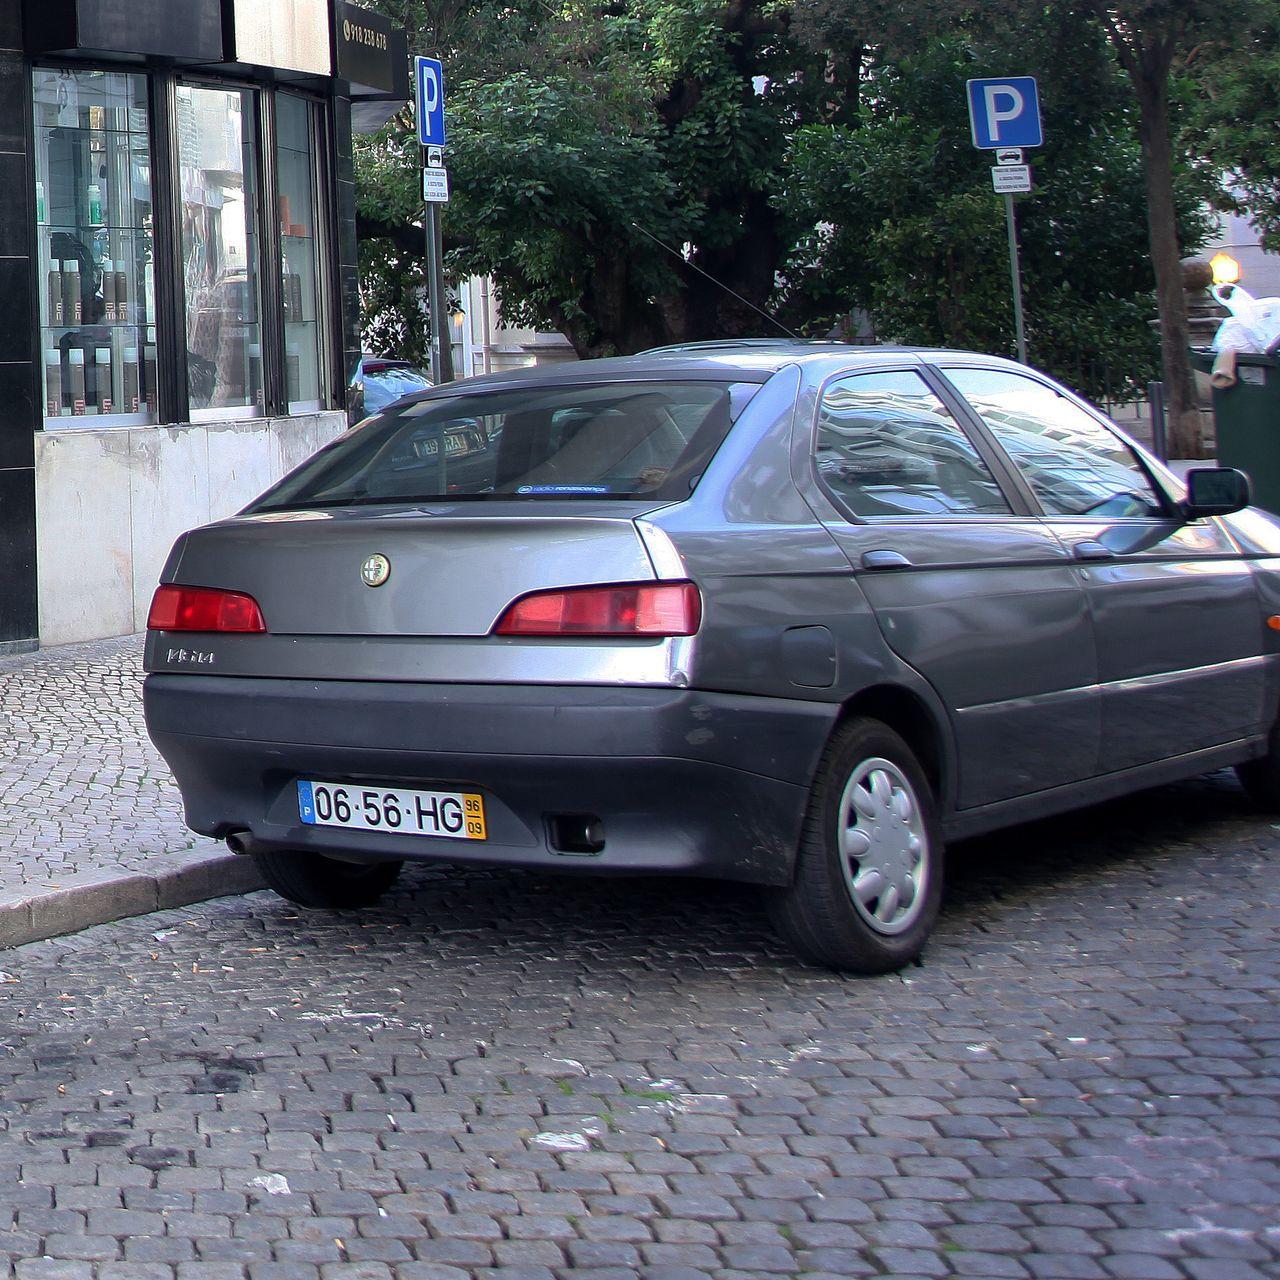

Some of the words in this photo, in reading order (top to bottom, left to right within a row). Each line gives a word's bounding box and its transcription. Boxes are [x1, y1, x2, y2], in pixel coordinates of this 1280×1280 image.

[423, 66, 438, 137] P
[983, 85, 1024, 142] P
[304, 807, 311, 816] P
[467, 821, 483, 835] 09
[465, 799, 480, 812] 96
